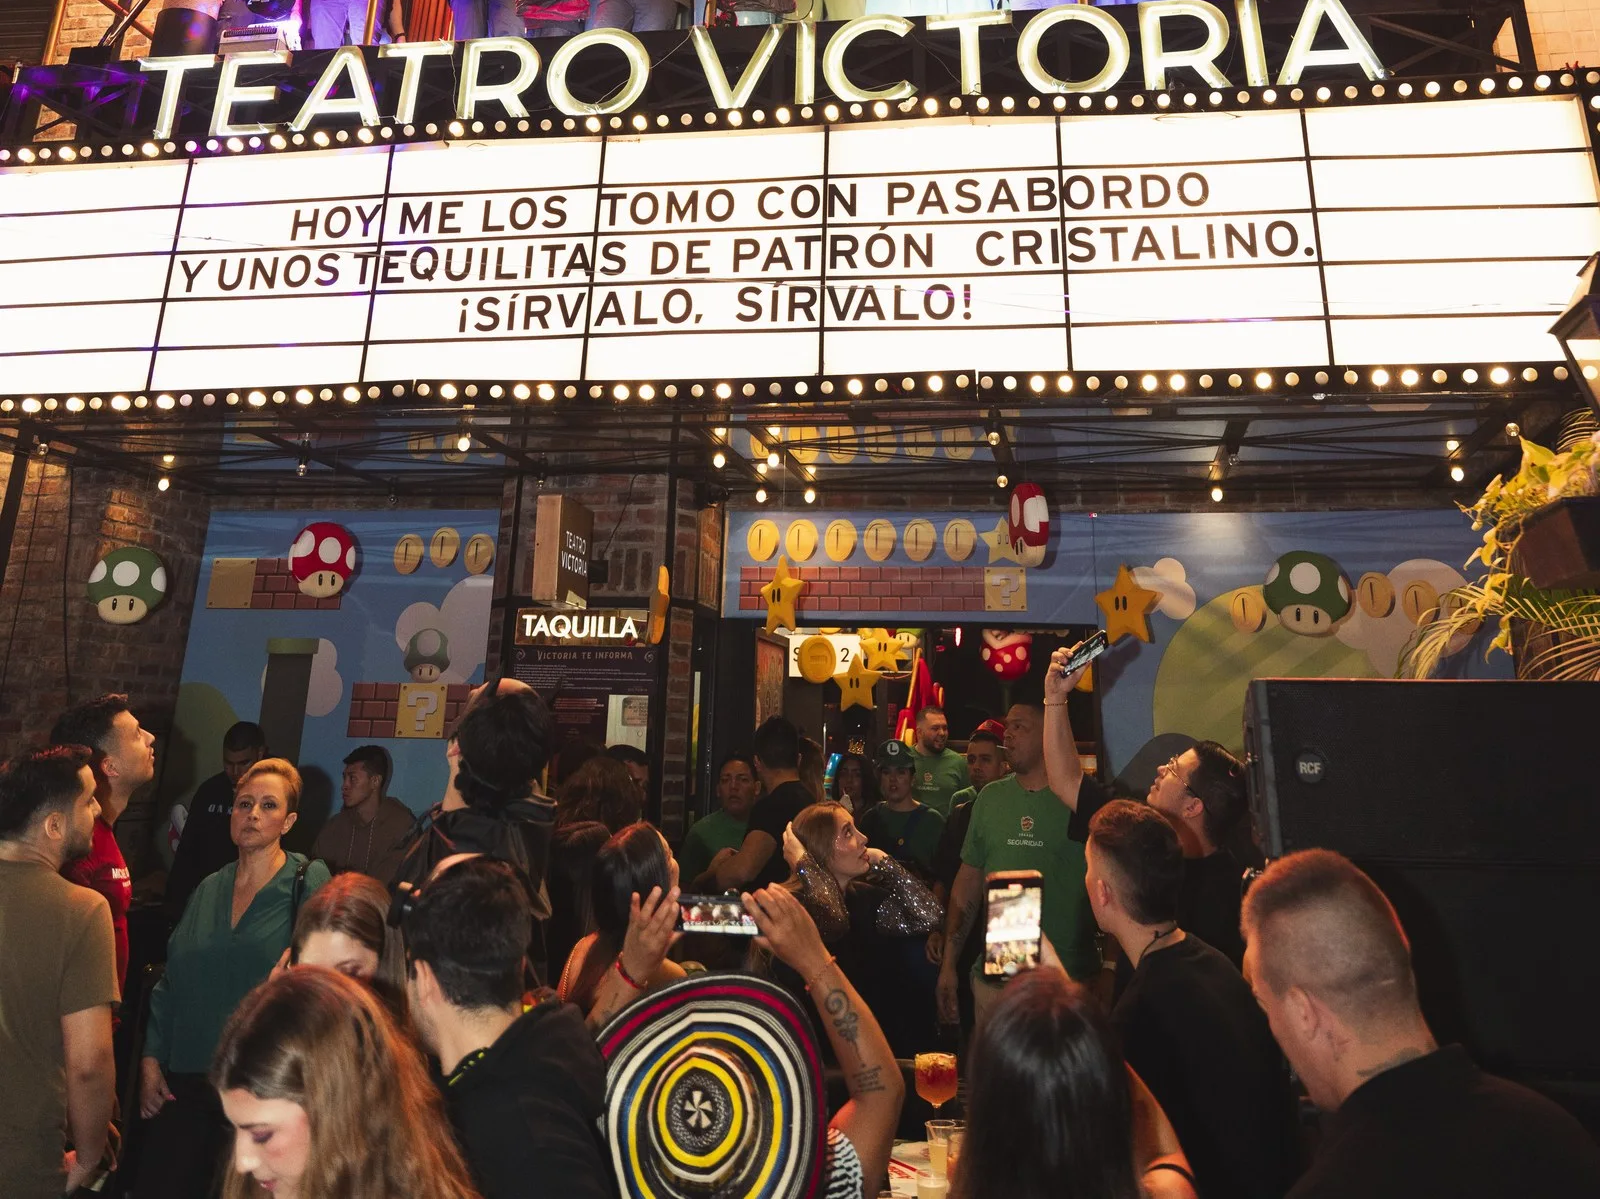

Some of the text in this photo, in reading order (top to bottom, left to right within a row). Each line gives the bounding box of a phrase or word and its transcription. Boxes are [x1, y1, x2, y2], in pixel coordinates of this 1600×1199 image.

[138, 27, 652, 139] TEATRO
[290, 171, 1210, 241] HOY ME LOS TOMO CON PASABORDO
[180, 220, 1315, 293] Y UNOS TEQUILITAS DE PATRÓN CRISTALINO.
[458, 280, 972, 333] ¡SÍRVALO, SÍRVALO!
[565, 530, 587, 556] TEATRO
[561, 550, 588, 577] VICTORIA
[521, 613, 639, 640] TAQUILLA
[840, 647, 850, 663] 2
[1299, 761, 1321, 774] RCF
[1006, 838, 1044, 847] SEGURIDAD
